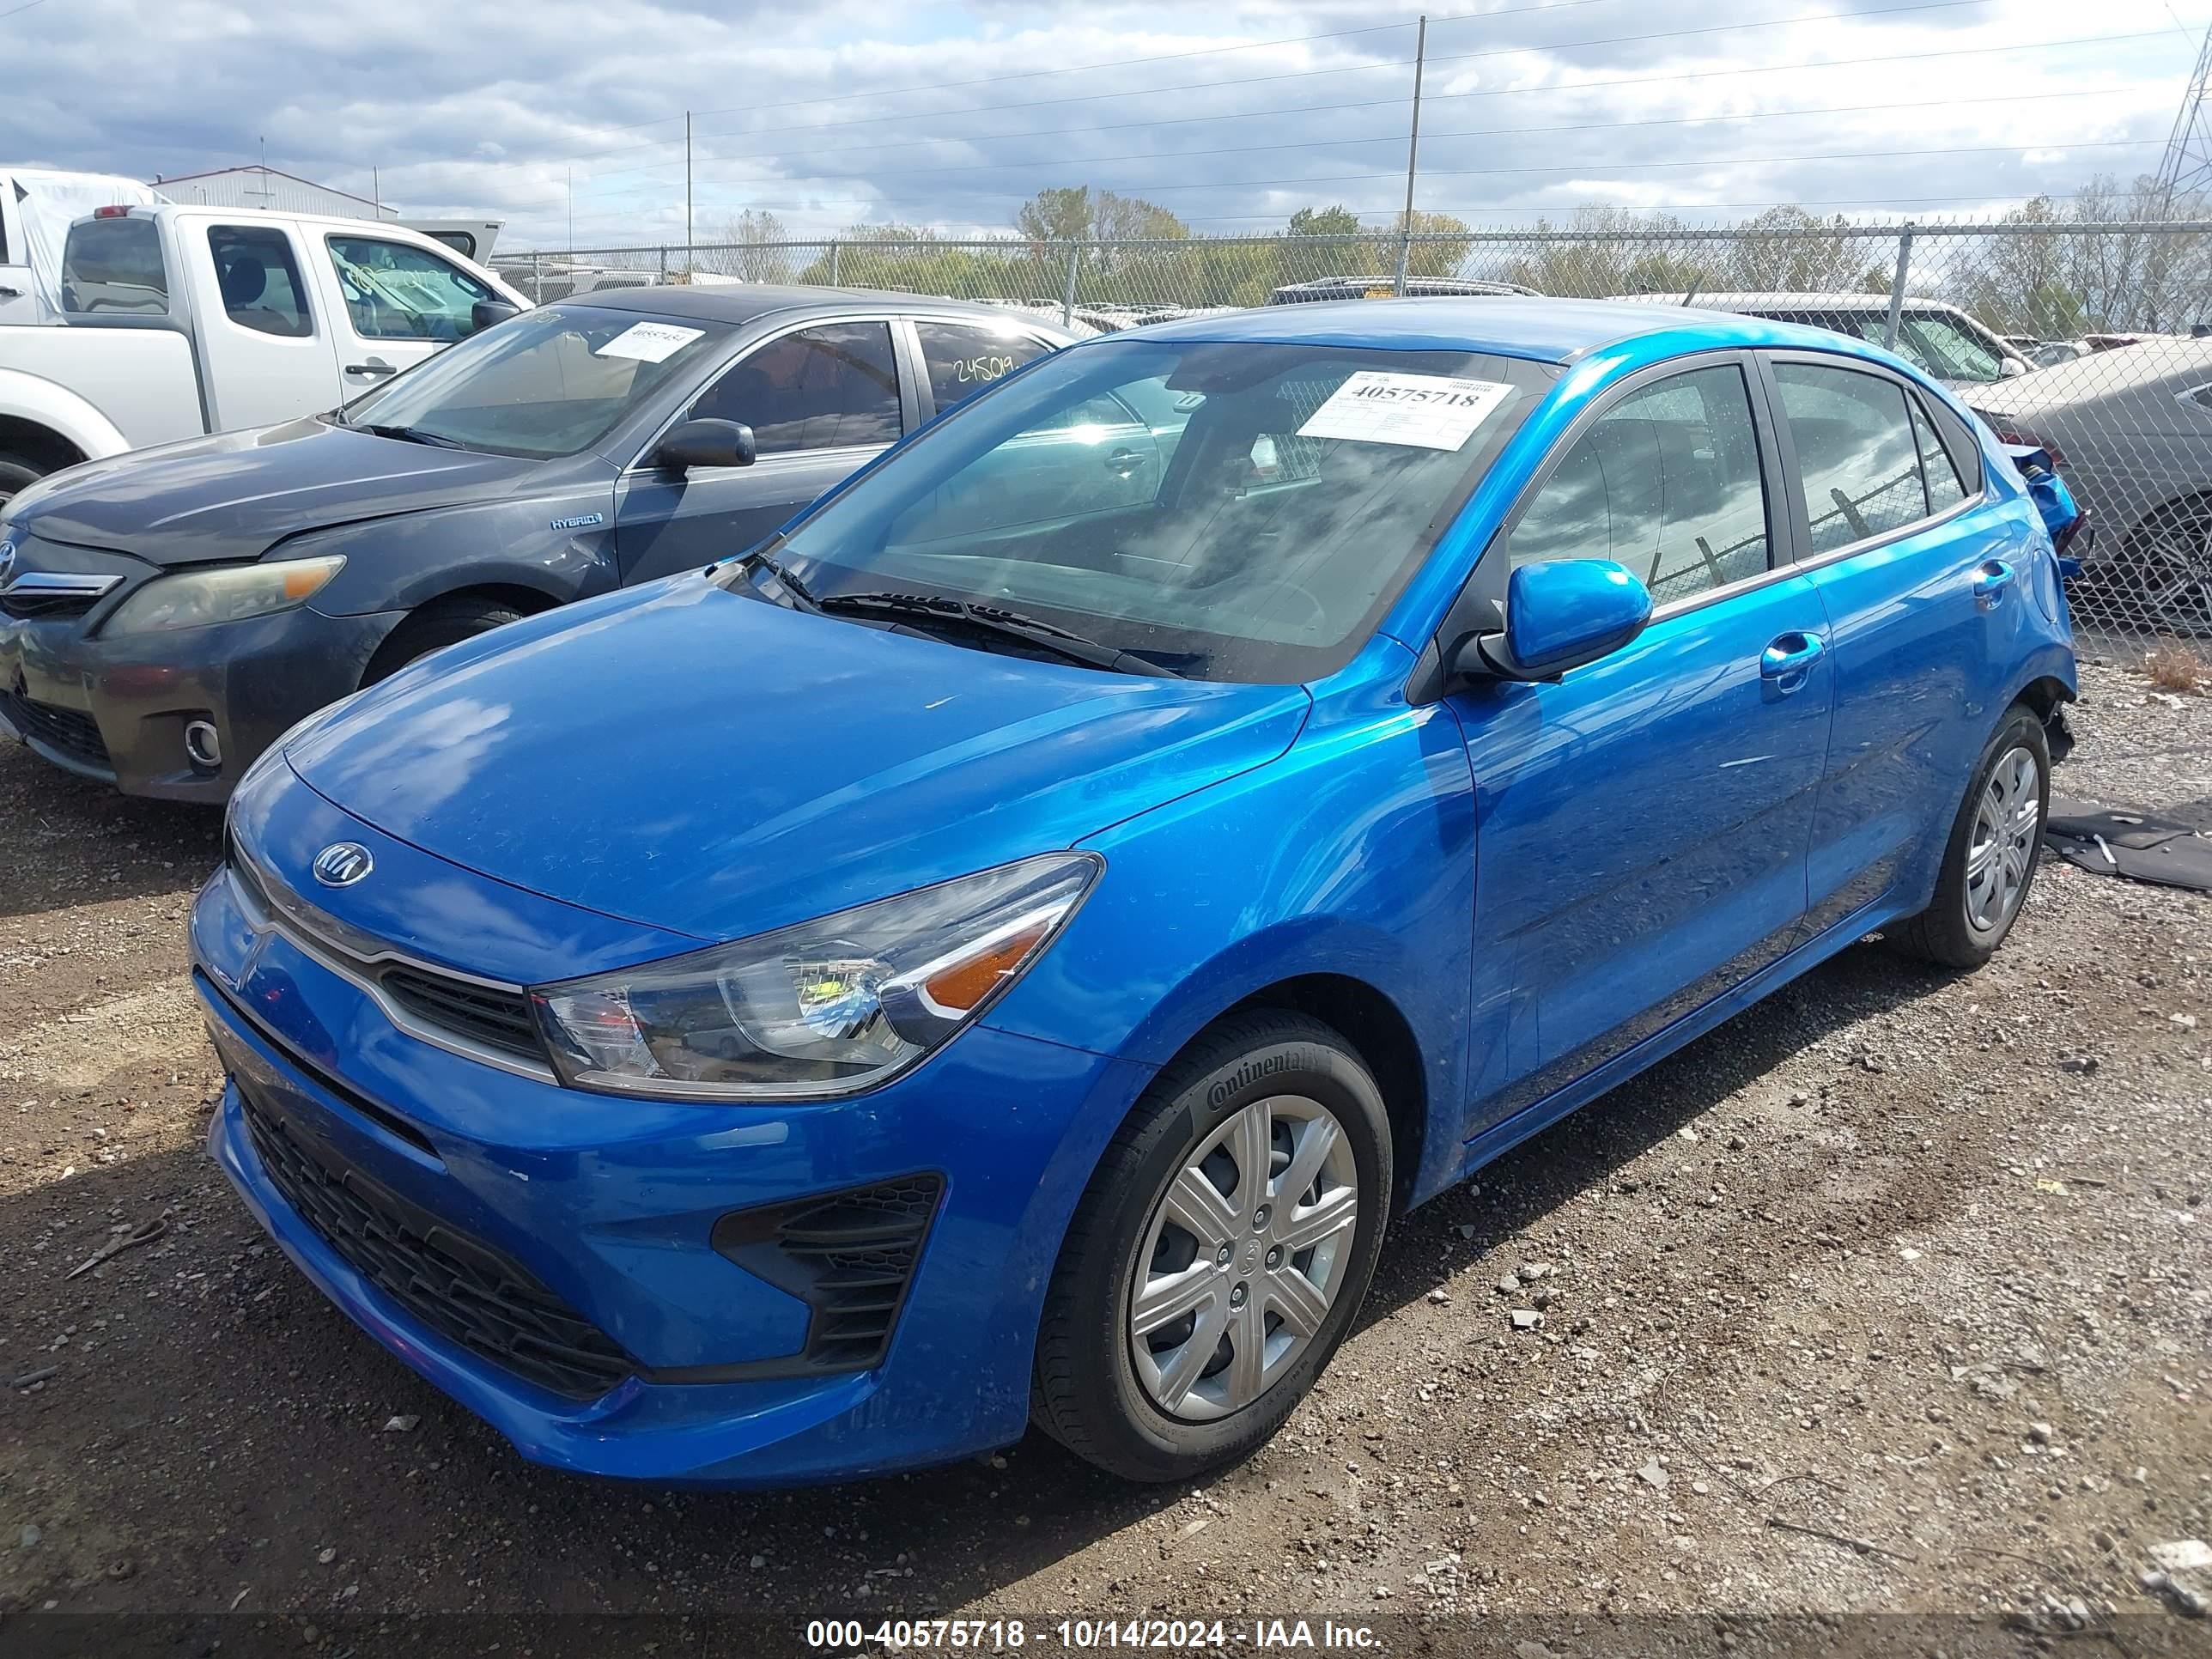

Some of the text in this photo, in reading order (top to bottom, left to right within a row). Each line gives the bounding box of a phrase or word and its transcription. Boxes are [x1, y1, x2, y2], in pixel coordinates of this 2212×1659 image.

[1352, 385, 1480, 407] 40575718
[550, 514, 596, 530] HYBRID
[316, 844, 362, 880] KIA
[1206, 1047, 1305, 1112] Continental
